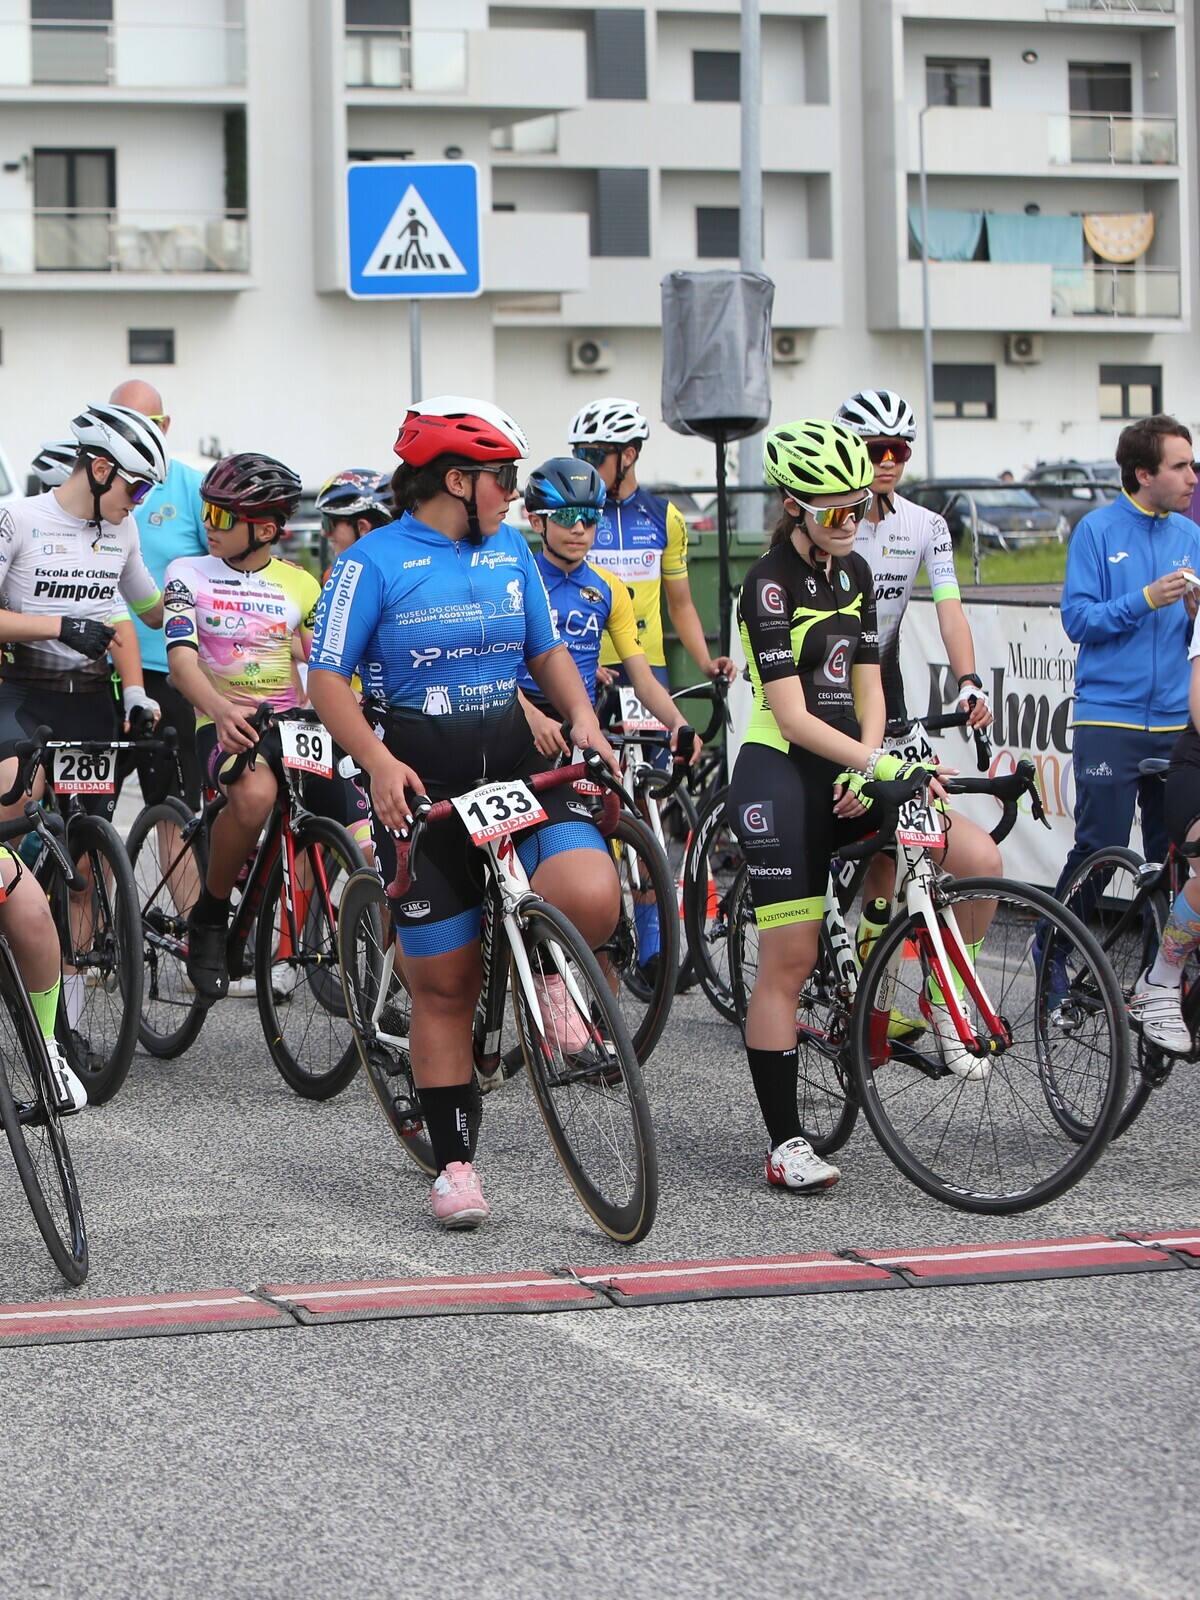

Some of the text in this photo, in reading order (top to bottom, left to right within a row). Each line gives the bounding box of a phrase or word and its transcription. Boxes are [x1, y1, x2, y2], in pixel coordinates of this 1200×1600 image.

[770, 465, 796, 486] RUDY
[888, 547, 917, 556] Pimpões
[35, 567, 120, 580] Escola de Ciclismo
[873, 572, 908, 583] Ciclismo
[33, 580, 115, 602] Pimpões
[212, 600, 285, 616] MATDIVER
[325, 563, 358, 650] institutoptico
[395, 602, 481, 620] MUSEU DO CICLISMO
[224, 616, 247, 630] CA
[397, 609, 483, 626] JOAQUIM AGOSTINHO
[439, 617, 463, 625] TORRES
[565, 609, 599, 638] CA
[458, 682, 495, 696] Torres
[818, 692, 830, 700] CEG
[295, 733, 323, 762] 89
[59, 754, 111, 782] 280
[286, 757, 330, 776] FIDELIDADE
[59, 782, 111, 790] FIDELIDADE
[474, 785, 507, 798] CICLISMO
[466, 790, 533, 829] 133
[476, 810, 541, 840] FIDELIDADE
[690, 802, 726, 882] ZIPP
[900, 831, 941, 844] FIDELIDADE
[408, 902, 423, 912] ARC
[763, 907, 811, 923] AZEITONENSE
